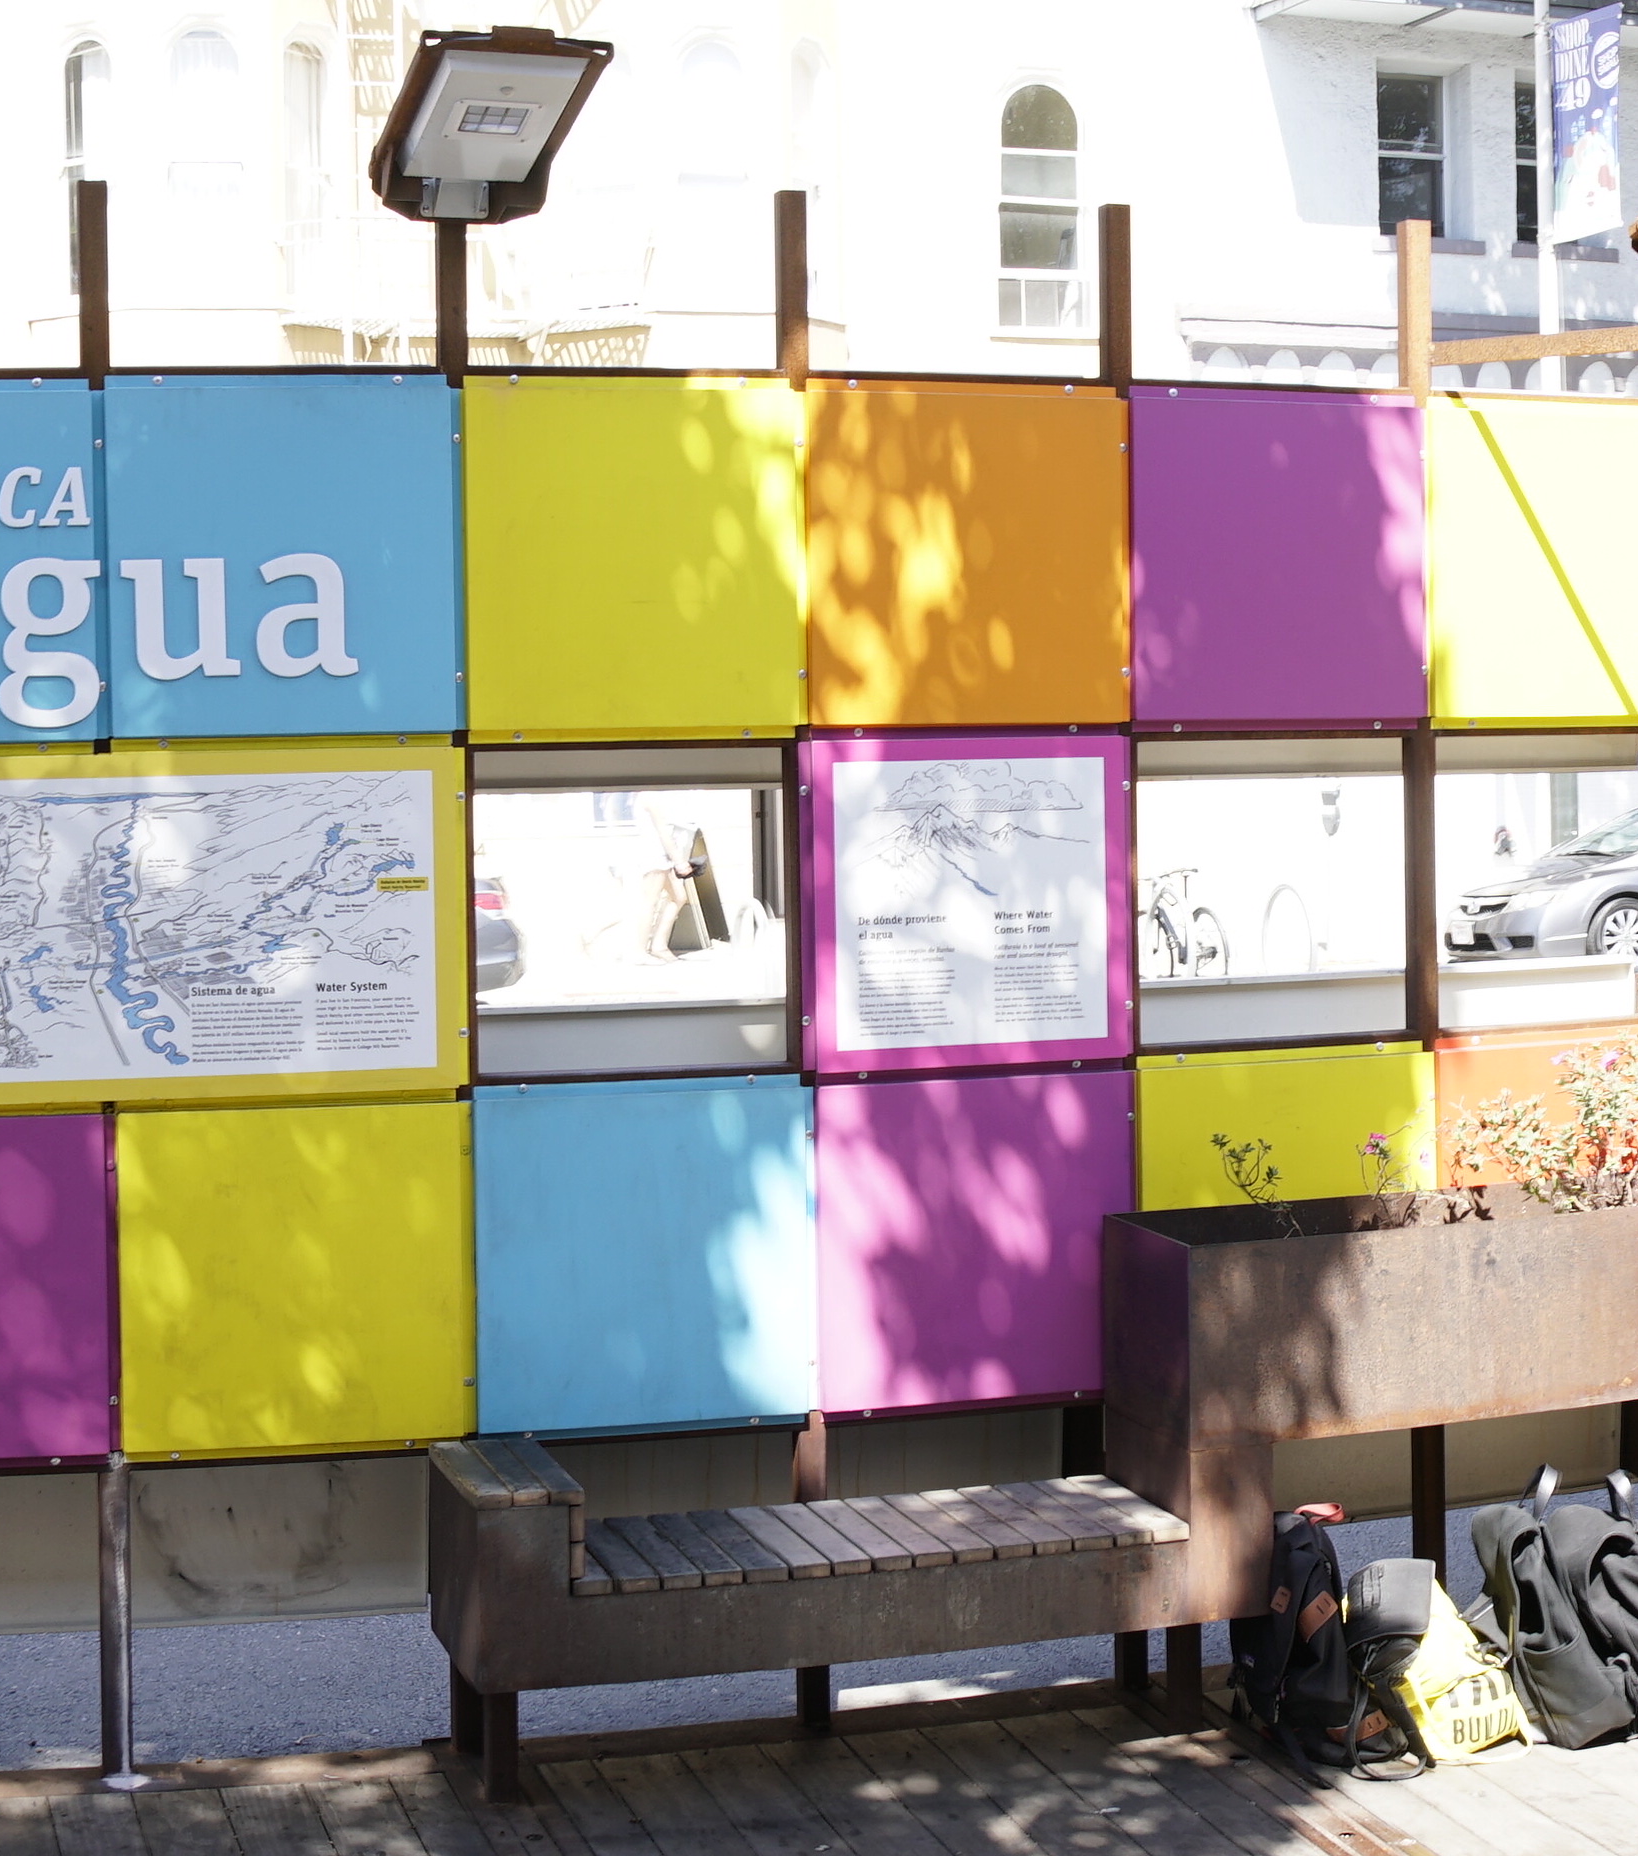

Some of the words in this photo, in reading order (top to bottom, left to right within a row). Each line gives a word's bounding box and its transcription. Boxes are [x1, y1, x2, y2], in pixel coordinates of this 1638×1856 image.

[1554, 19, 1589, 52] SHOP
[1555, 45, 1589, 82] DINE
[1555, 77, 1591, 111] 49
[858, 917, 870, 926] De
[874, 915, 902, 925] dónde
[905, 914, 947, 926] proviene
[994, 911, 1023, 920] Where
[1026, 910, 1053, 919] Water
[994, 926, 1023, 934] Comes
[1027, 924, 1050, 933] From
[859, 931, 867, 940] el
[871, 931, 893, 940] agua
[191, 986, 233, 996] Sistema
[236, 986, 248, 995] de
[251, 986, 275, 997] agua
[316, 983, 347, 992] Water
[350, 982, 388, 993] System
